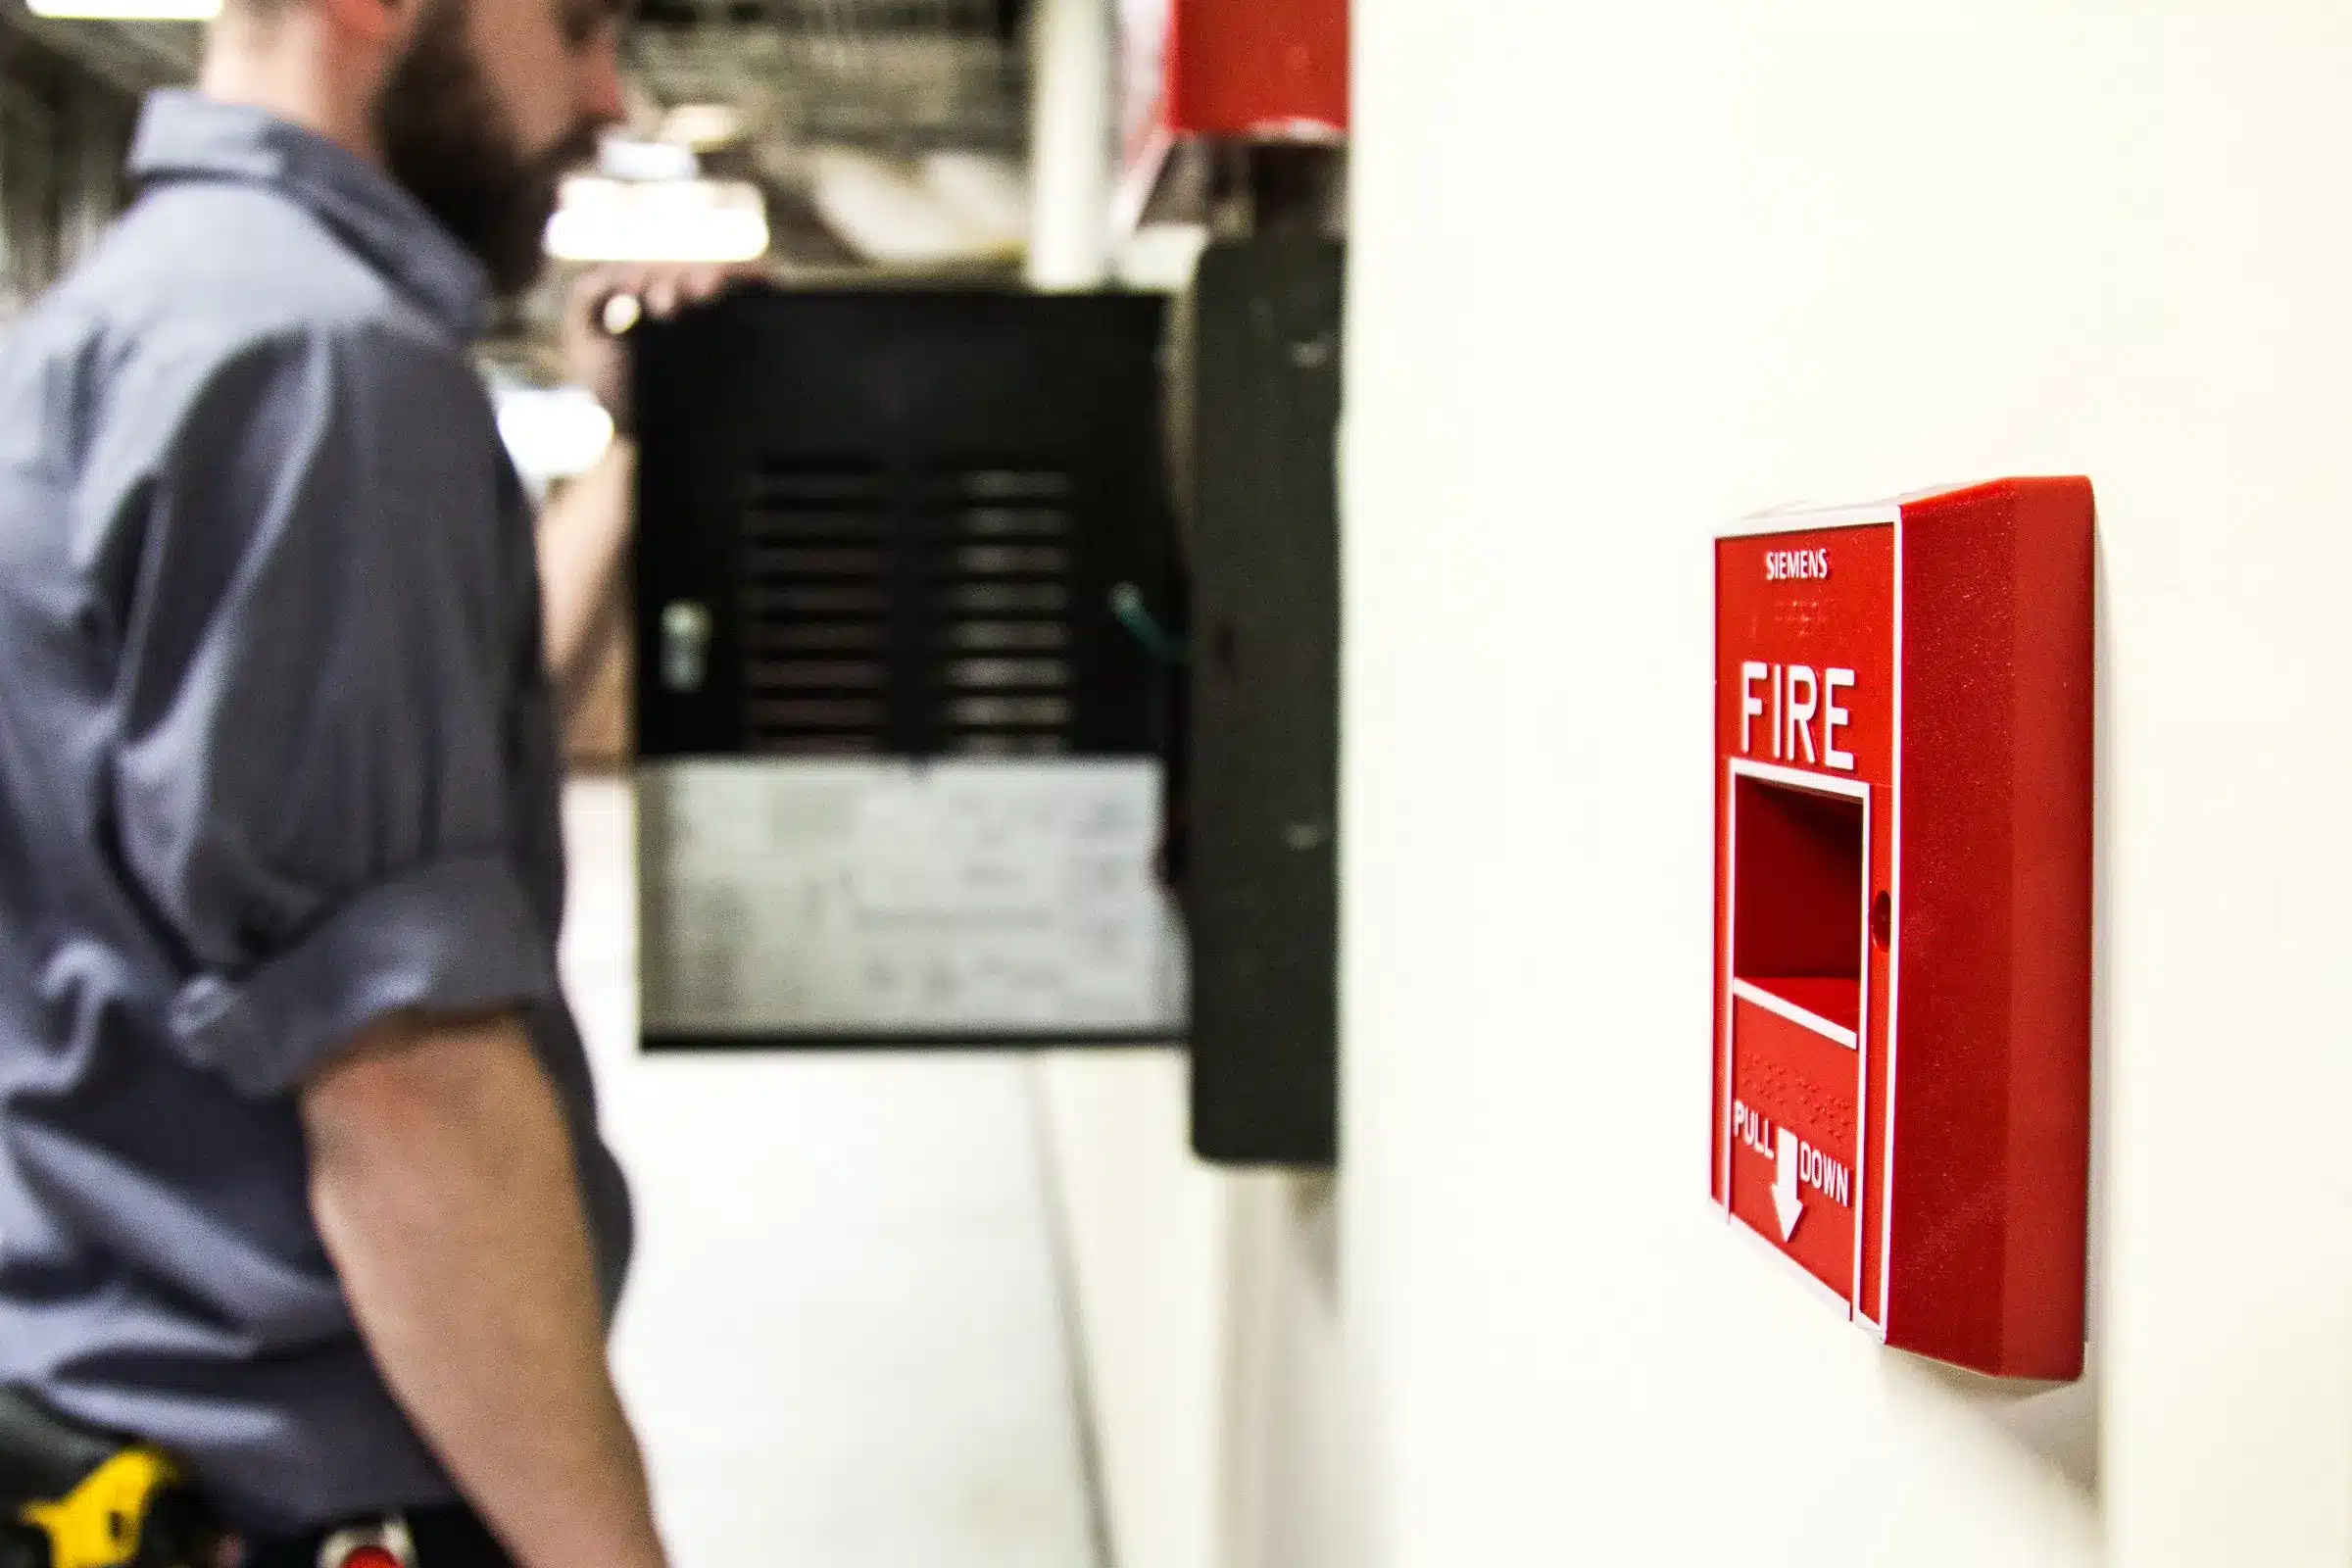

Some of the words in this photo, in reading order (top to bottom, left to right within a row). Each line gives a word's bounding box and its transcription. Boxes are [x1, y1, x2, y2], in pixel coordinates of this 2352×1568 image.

[1765, 548, 1828, 581] SIEMENS
[1740, 661, 1856, 771] FIRE
[1733, 1099, 1774, 1160] PULL
[1799, 1141, 1849, 1208] DOWN
